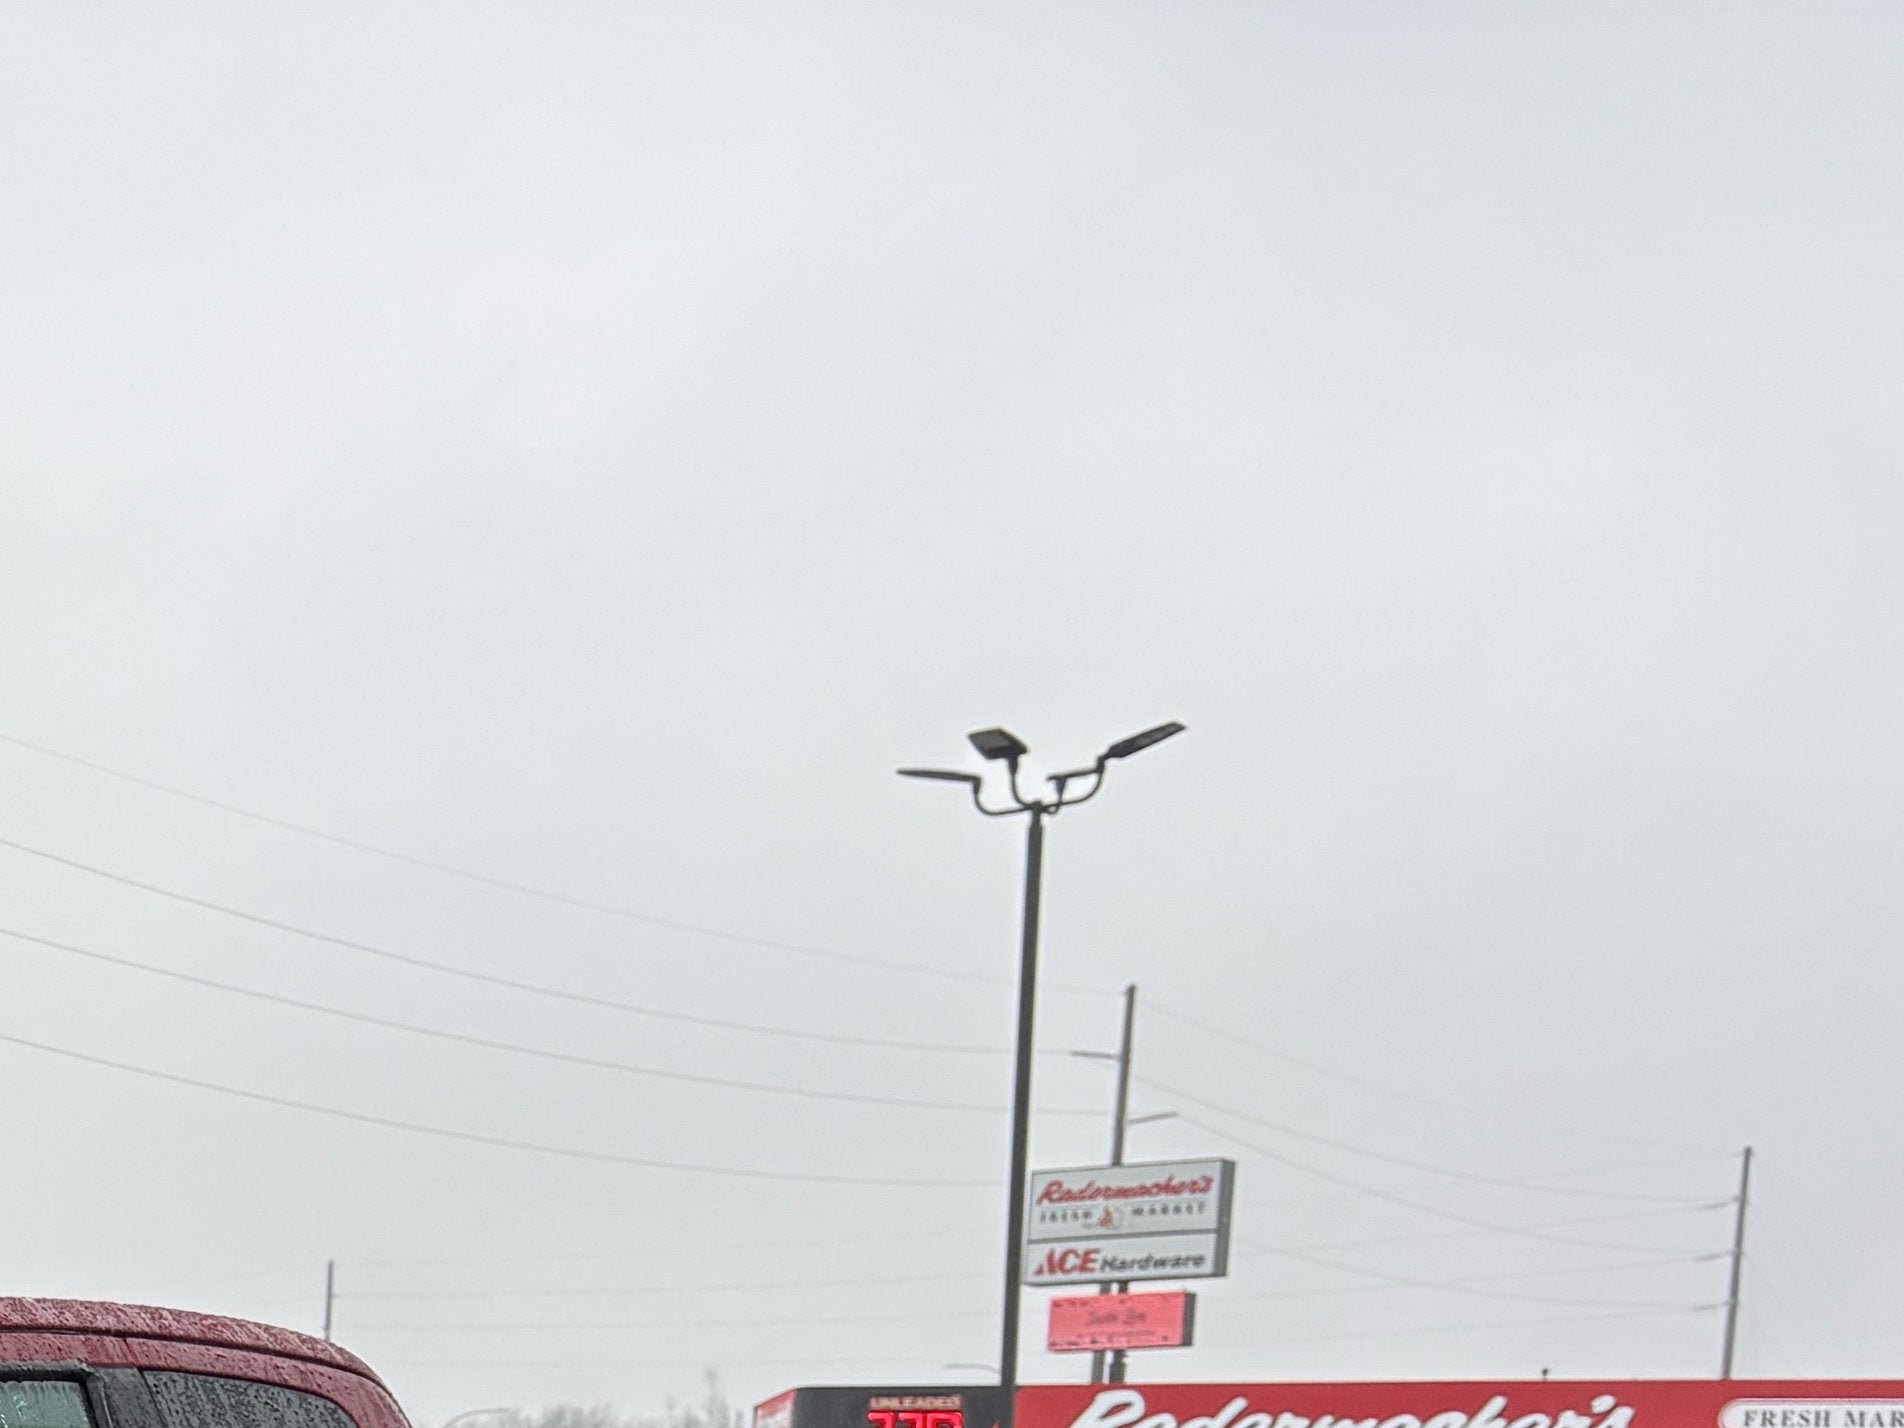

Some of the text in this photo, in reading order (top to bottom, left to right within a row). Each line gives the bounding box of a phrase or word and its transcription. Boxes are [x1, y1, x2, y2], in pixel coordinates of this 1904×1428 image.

[1034, 1248, 1206, 1276] ACE Hardware
[1743, 1410, 1831, 1428] FRESH
